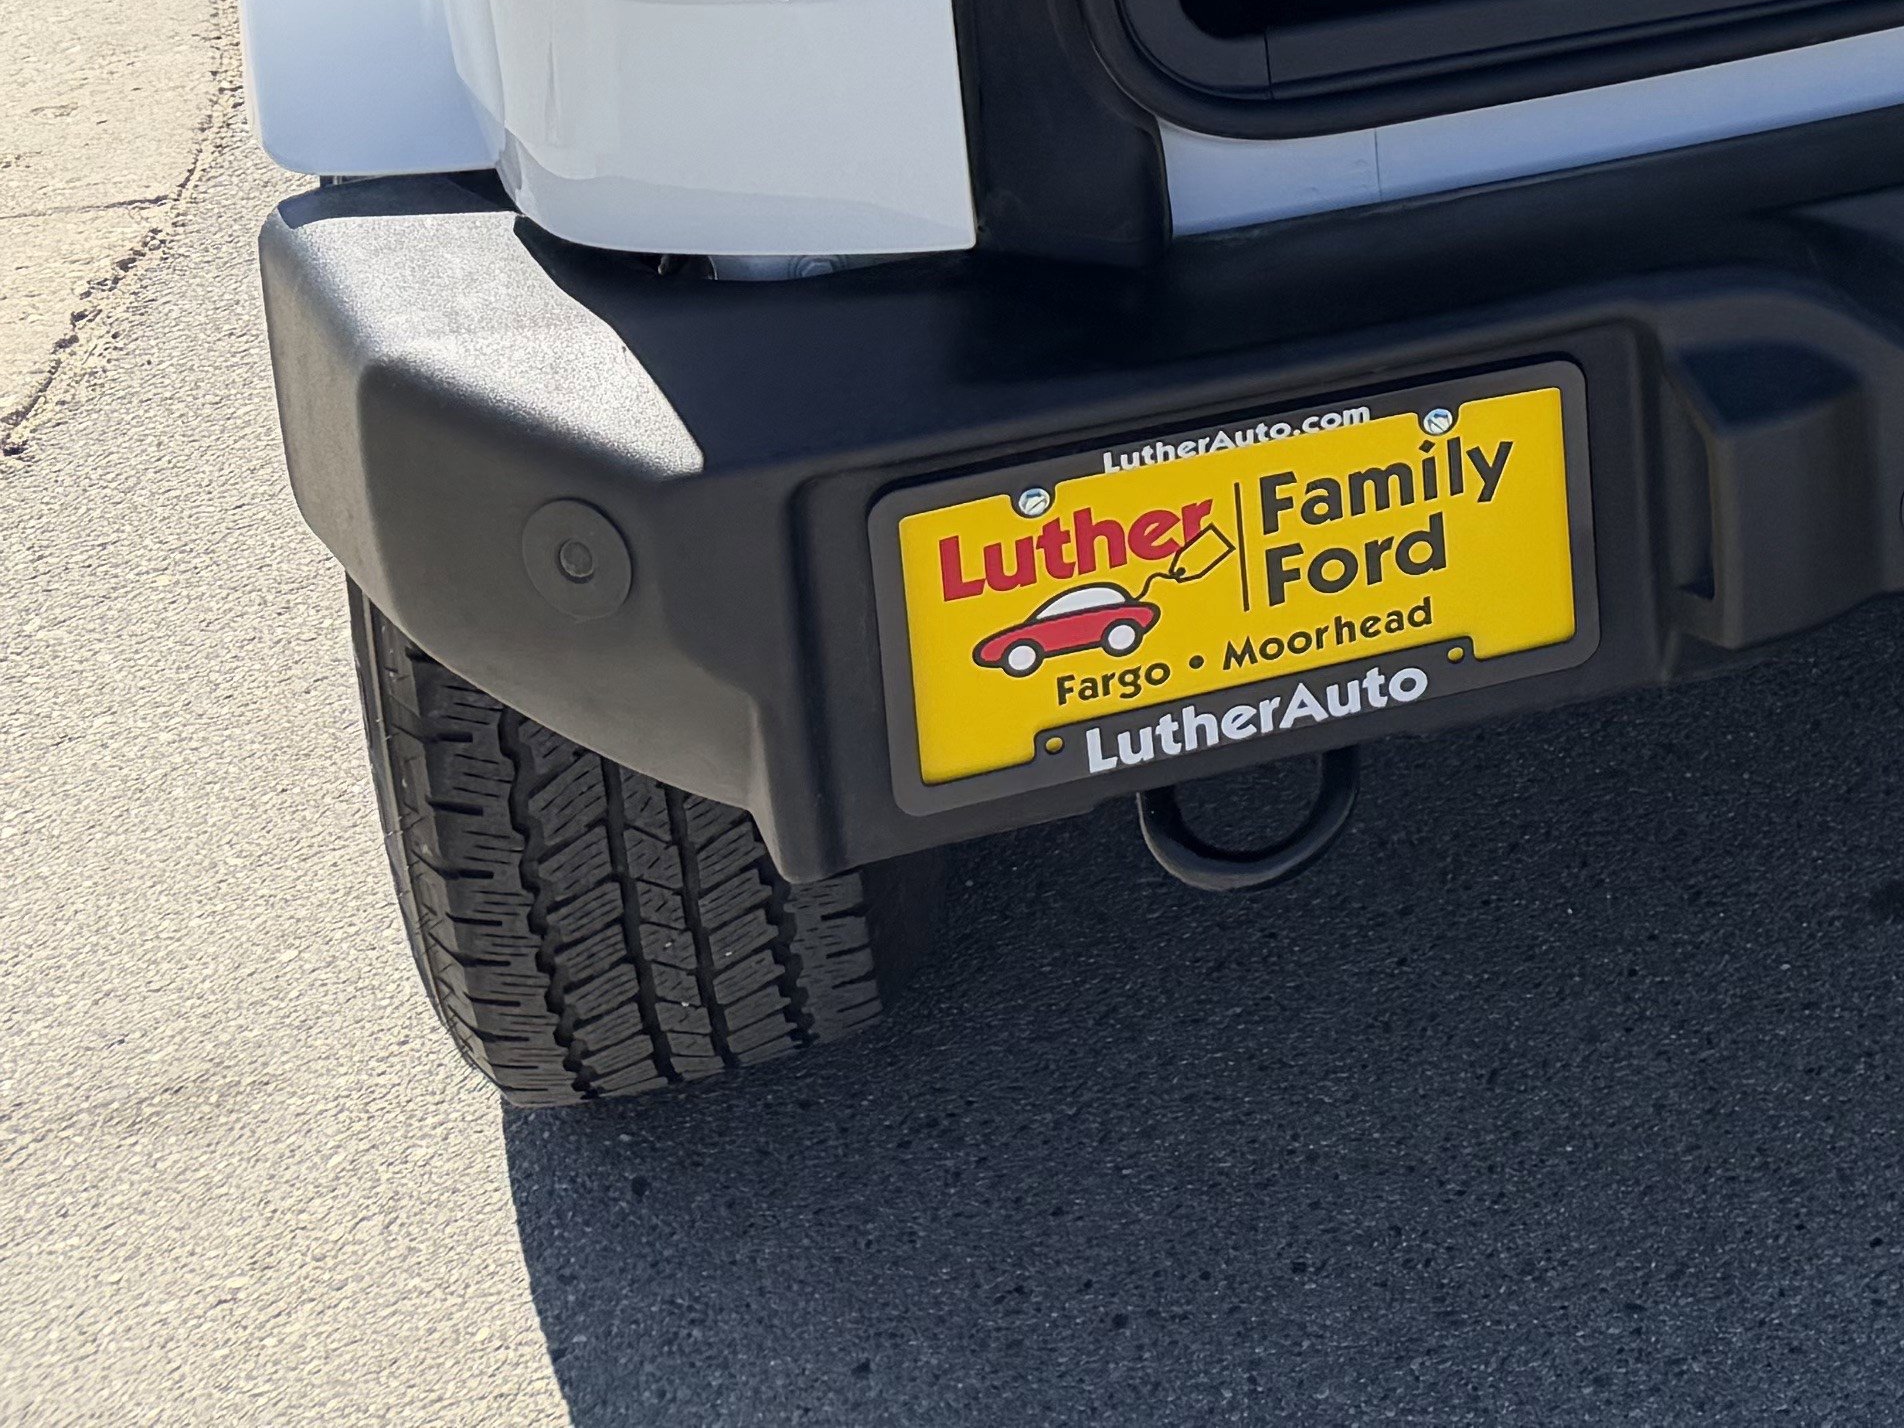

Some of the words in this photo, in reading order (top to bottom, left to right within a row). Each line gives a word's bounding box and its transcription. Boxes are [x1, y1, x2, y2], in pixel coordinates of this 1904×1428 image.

[1103, 406, 1370, 474] LutherAuto.com
[1259, 436, 1513, 535] Family
[939, 498, 1213, 602] Luther
[1265, 511, 1447, 607] Ford
[1056, 662, 1171, 705] Fargo
[1222, 596, 1432, 671] Moorhead
[1086, 667, 1428, 774] LutherAuto
